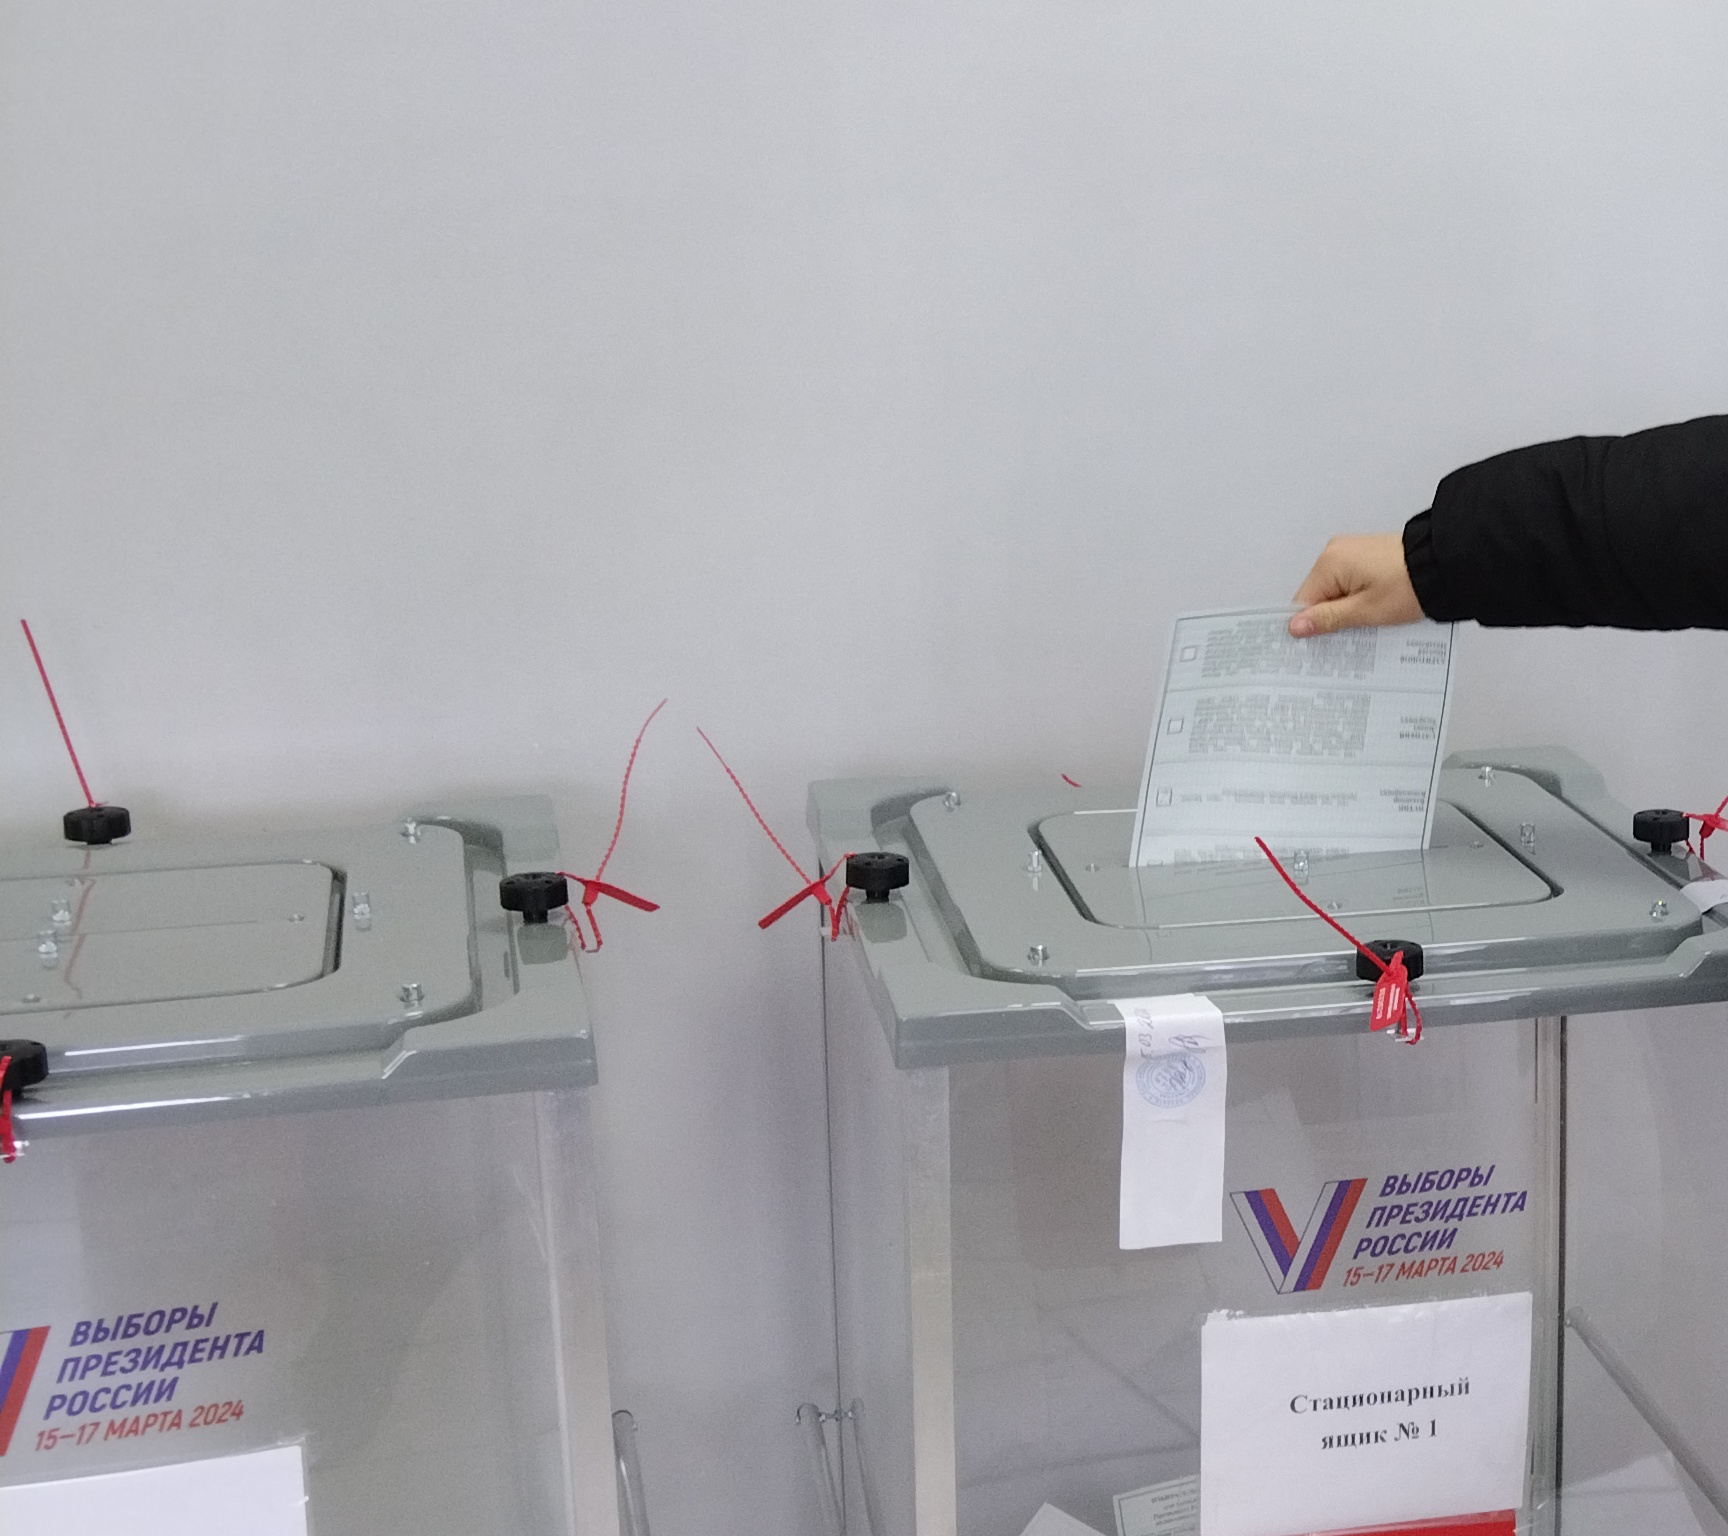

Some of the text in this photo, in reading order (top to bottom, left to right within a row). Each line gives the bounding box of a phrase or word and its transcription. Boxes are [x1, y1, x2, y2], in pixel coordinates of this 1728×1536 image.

[1379, 1165, 1495, 1197] ВЫБОРЫ
[1366, 1191, 1527, 1229] ПРЕЗИДЕНТА
[1353, 1228, 1458, 1259] РОССИИ
[1395, 1256, 1457, 1281] МАРТА
[1460, 1251, 1503, 1273] 2024
[70, 1302, 218, 1346] ВЫБОРЫ
[57, 1329, 264, 1382] ПРЕЗИДЕНТА
[44, 1377, 179, 1420] РОССИИ
[1289, 1377, 1470, 1414] Стационарный
[104, 1409, 182, 1440] МАРТА
[189, 1400, 243, 1427] 2024
[1320, 1428, 1388, 1450] ящик
